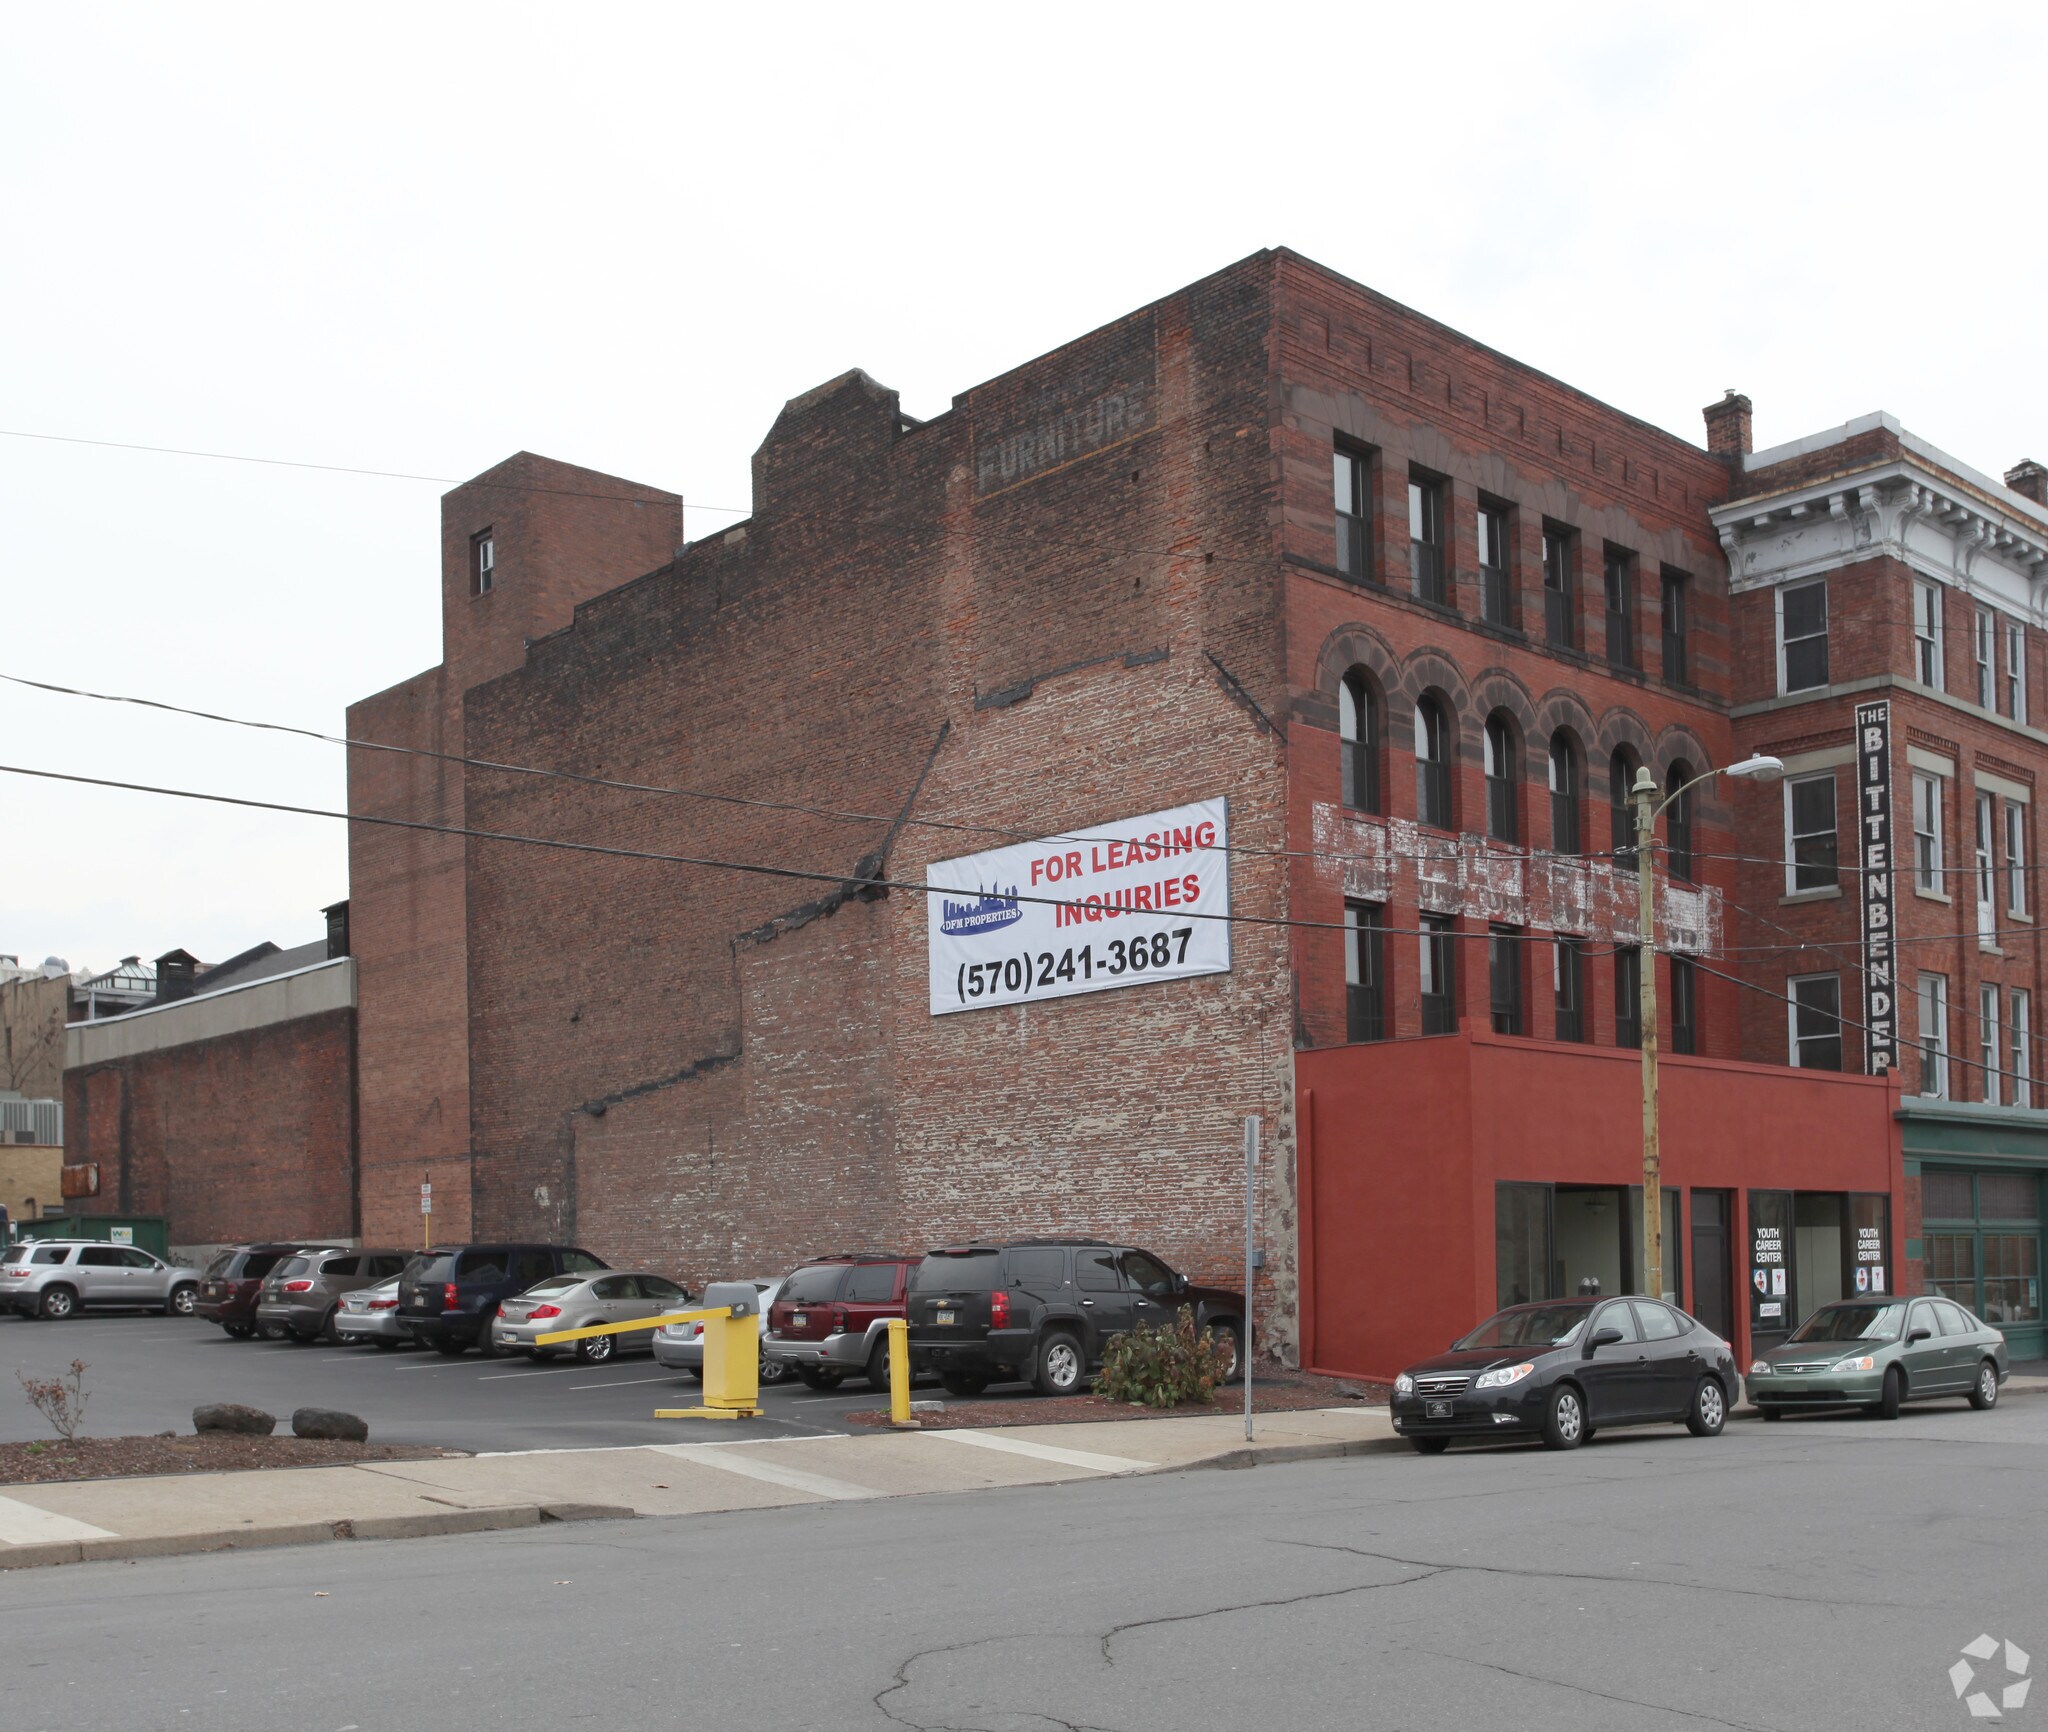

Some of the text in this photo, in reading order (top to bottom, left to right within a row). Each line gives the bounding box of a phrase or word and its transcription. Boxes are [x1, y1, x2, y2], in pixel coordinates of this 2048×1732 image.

[1859, 708, 1886, 724] THE
[1031, 821, 1216, 887] FOR LEASING
[1055, 874, 1201, 928] INQUIRIES
[1864, 727, 1891, 1076] BITTENBENDER
[945, 908, 1017, 931] DFM PROPERTIES
[1757, 1228, 1779, 1239] YOUTH
[1858, 1228, 1879, 1238] YOUTH
[1755, 1240, 1782, 1251] CAREER
[1857, 1240, 1880, 1250] CAREER
[1756, 1252, 1782, 1263] CENTER
[1858, 1251, 1881, 1261] CENTER
